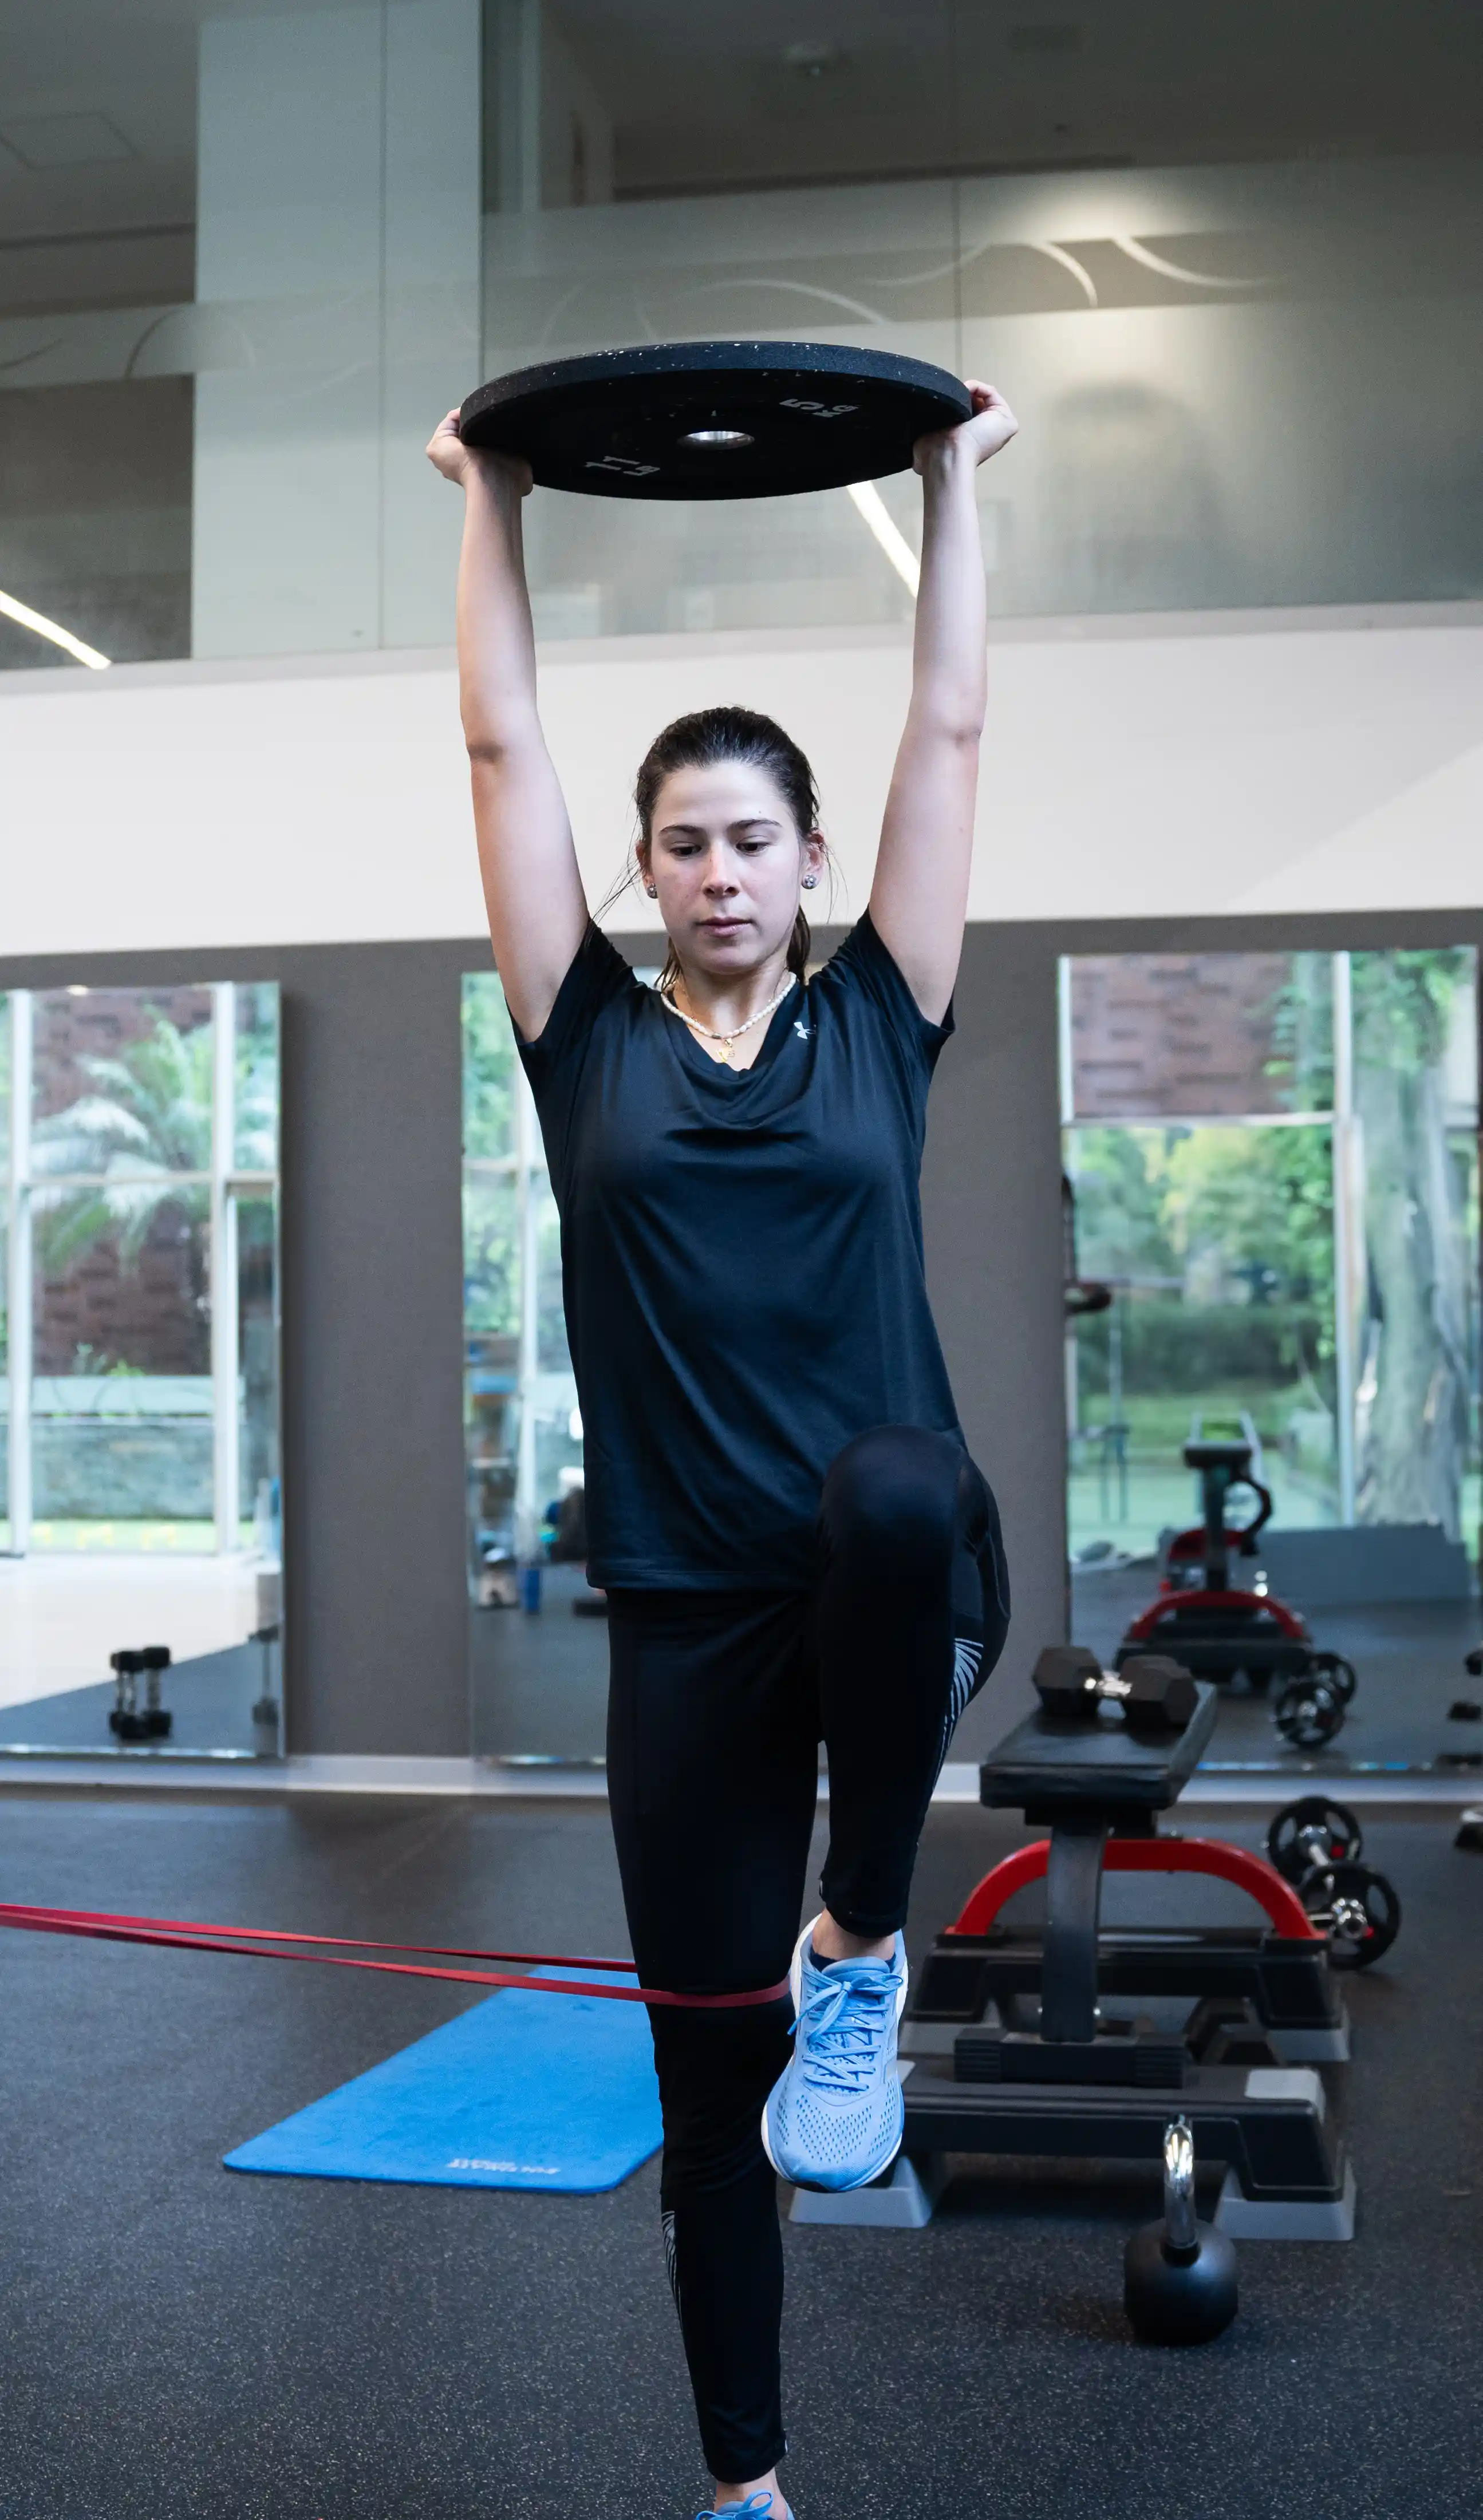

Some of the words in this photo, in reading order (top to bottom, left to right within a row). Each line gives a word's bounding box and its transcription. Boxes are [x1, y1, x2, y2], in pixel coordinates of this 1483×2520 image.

[779, 399, 825, 410] 5
[812, 405, 859, 417] KG
[585, 456, 641, 470] 11
